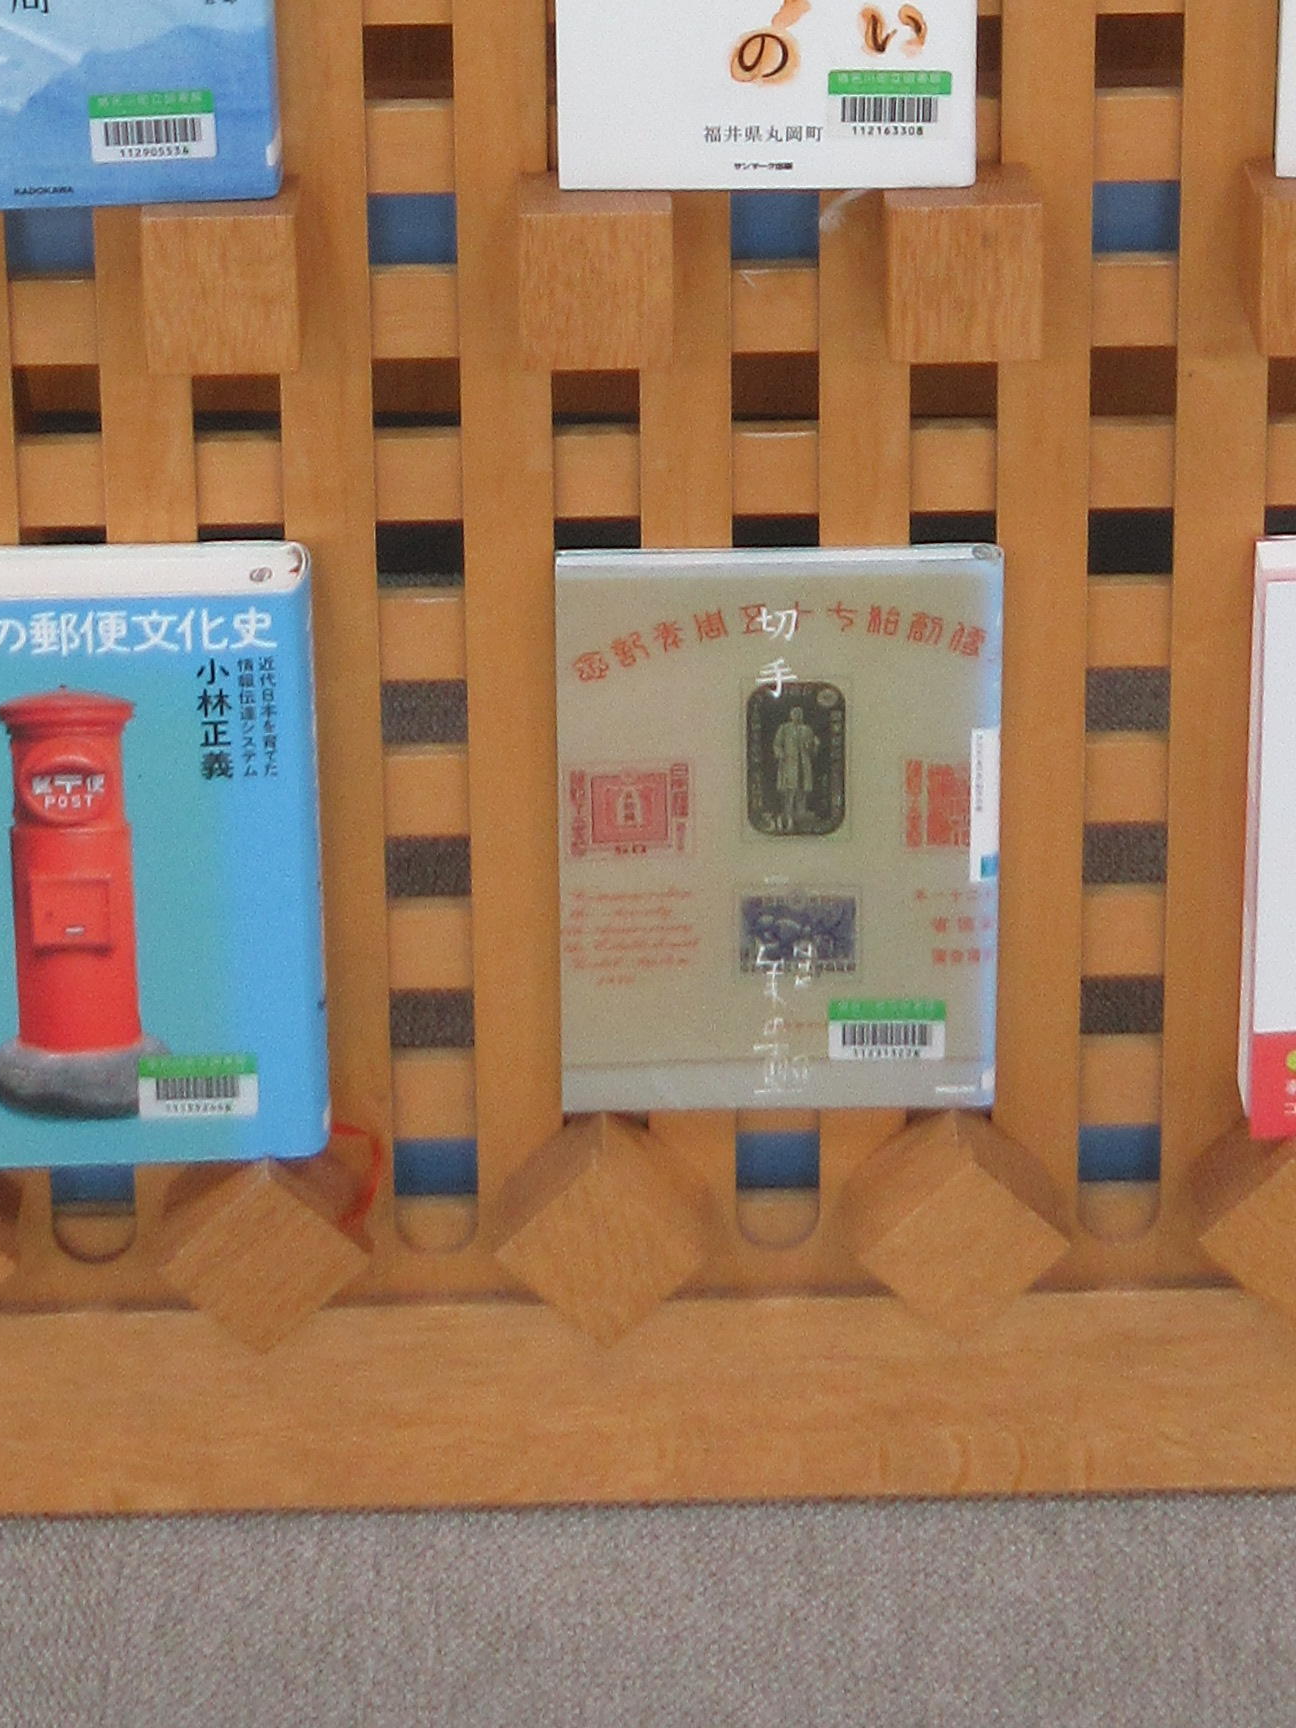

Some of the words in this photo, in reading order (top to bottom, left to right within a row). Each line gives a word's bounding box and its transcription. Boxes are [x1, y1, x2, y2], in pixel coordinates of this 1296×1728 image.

[704, 125, 824, 143] 福井県丸岡町
[14, 187, 74, 195] KADOKAWA
[196, 658, 233, 781] 小林正義
[44, 795, 93, 809] POST
